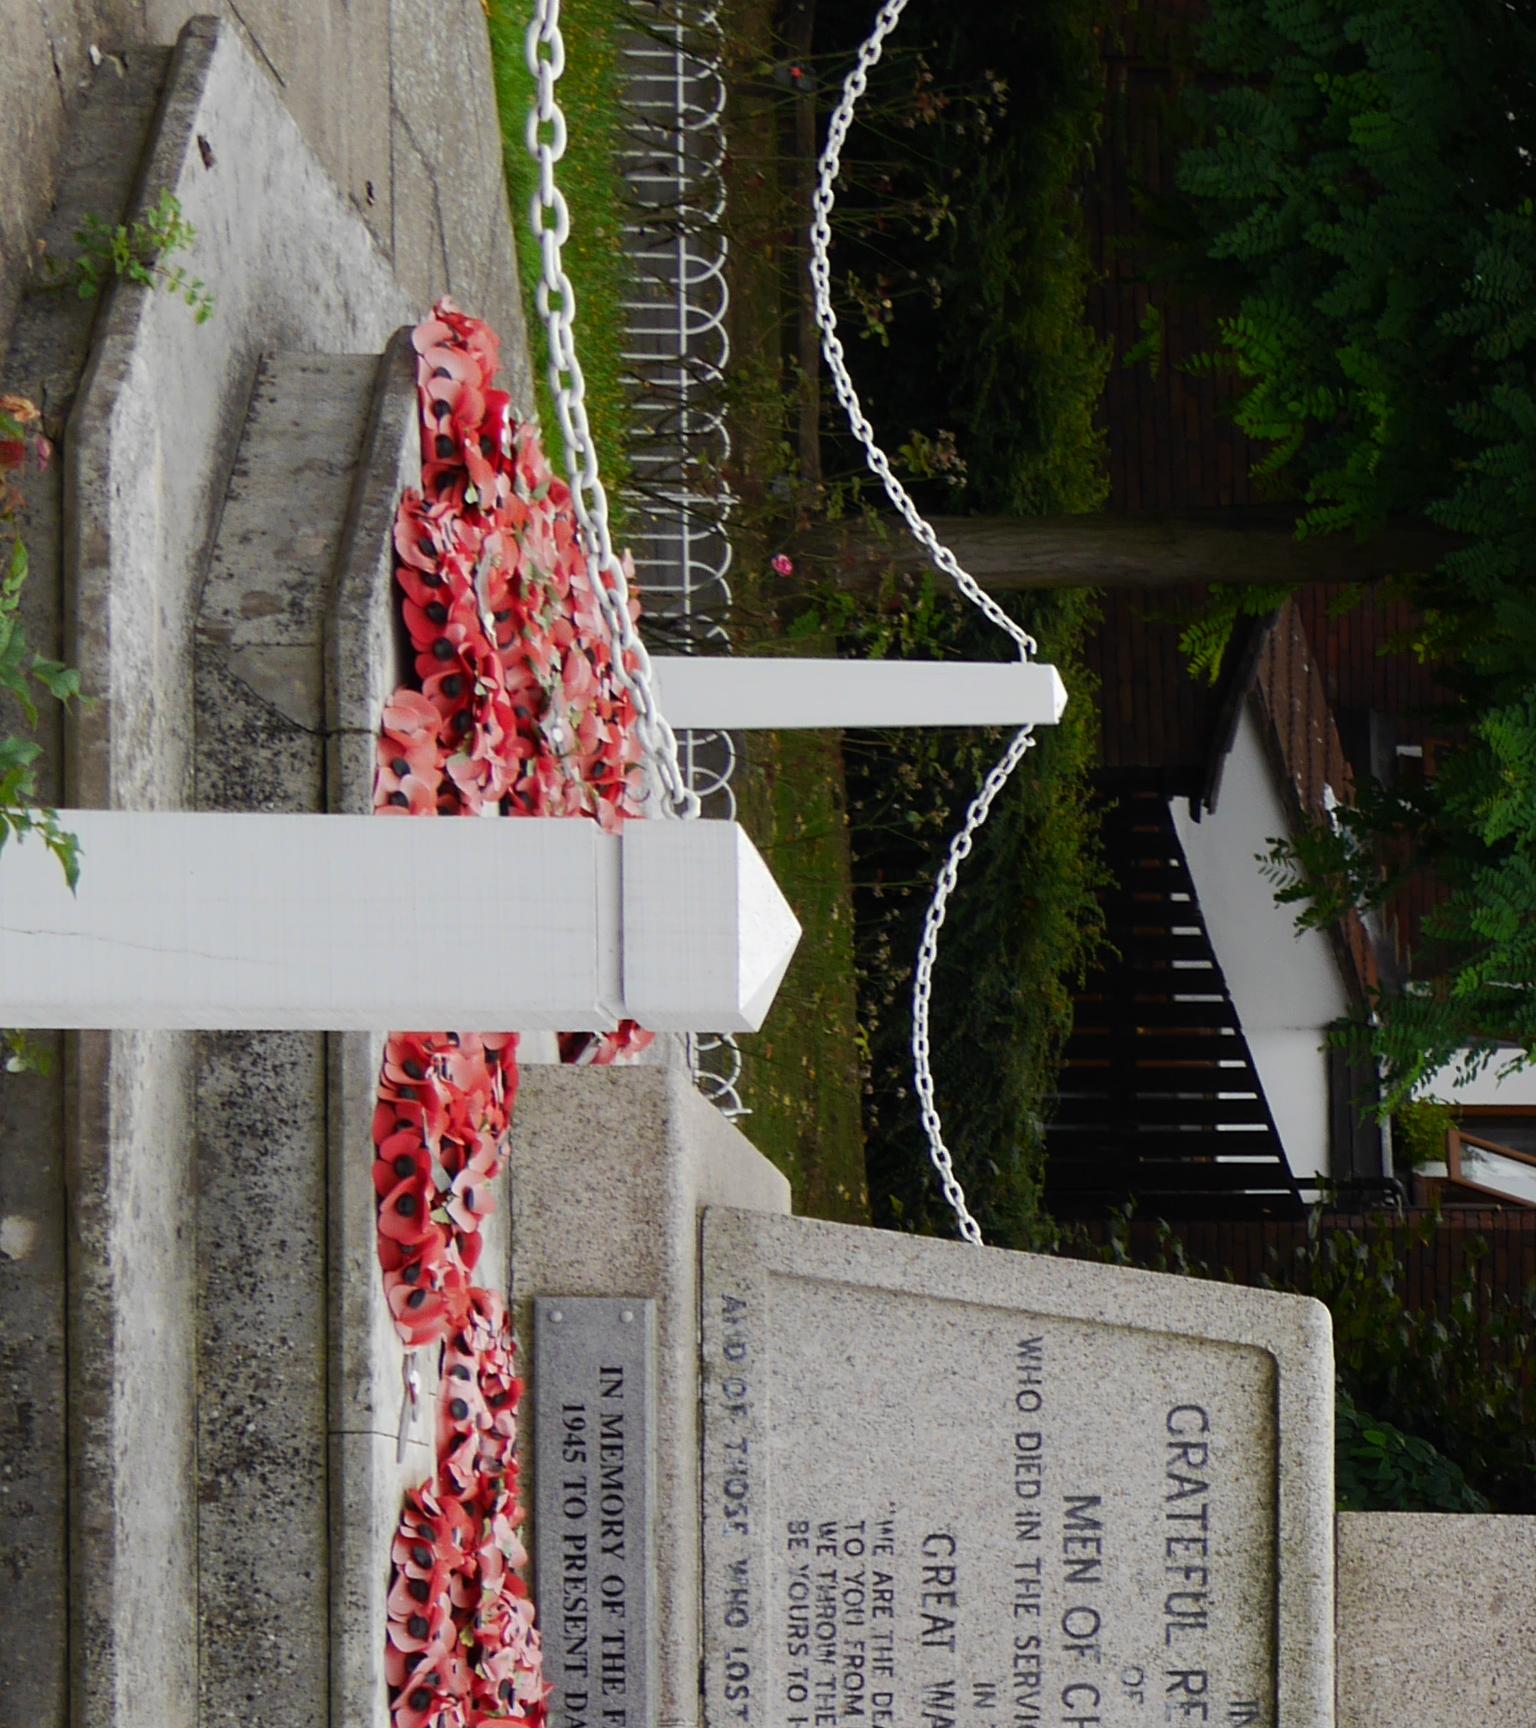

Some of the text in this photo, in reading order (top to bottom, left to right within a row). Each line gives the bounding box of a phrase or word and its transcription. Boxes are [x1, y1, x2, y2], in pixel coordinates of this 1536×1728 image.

[721, 1294, 748, 1361] AND
[599, 1365, 624, 1399] IN
[720, 1377, 749, 1420] OF
[1016, 1336, 1042, 1413] WHO
[561, 1403, 587, 1463] 1945
[598, 1412, 625, 1561] MEMORY
[722, 1437, 749, 1536] THOSE
[1015, 1431, 1042, 1499] DIED
[562, 1475, 588, 1520] TO
[1015, 1511, 1042, 1541] IN
[1165, 1403, 1210, 1646] GRATEFUL
[787, 1520, 809, 1550] BE
[816, 1521, 837, 1557] WE
[844, 1520, 865, 1556] TO
[1062, 1495, 1102, 1583] MEN
[562, 1533, 588, 1678] PRESENT
[599, 1574, 625, 1619] OF
[723, 1558, 750, 1629] WHO
[787, 1565, 809, 1656] YOURS
[814, 1569, 837, 1664] THROW
[842, 1570, 865, 1626] YOU
[871, 1570, 894, 1618] ARE
[920, 1533, 956, 1654] GREAT
[1014, 1557, 1041, 1618] THE
[600, 1629, 626, 1696] THE
[871, 1632, 894, 1678] THE
[1061, 1606, 1102, 1664] OF
[722, 1646, 750, 1723] LOST
[786, 1668, 809, 1703] TO
[814, 1674, 837, 1727] THE
[842, 1641, 865, 1716] FROM
[972, 1682, 996, 1708] IN
[1120, 1665, 1145, 1704] OF
